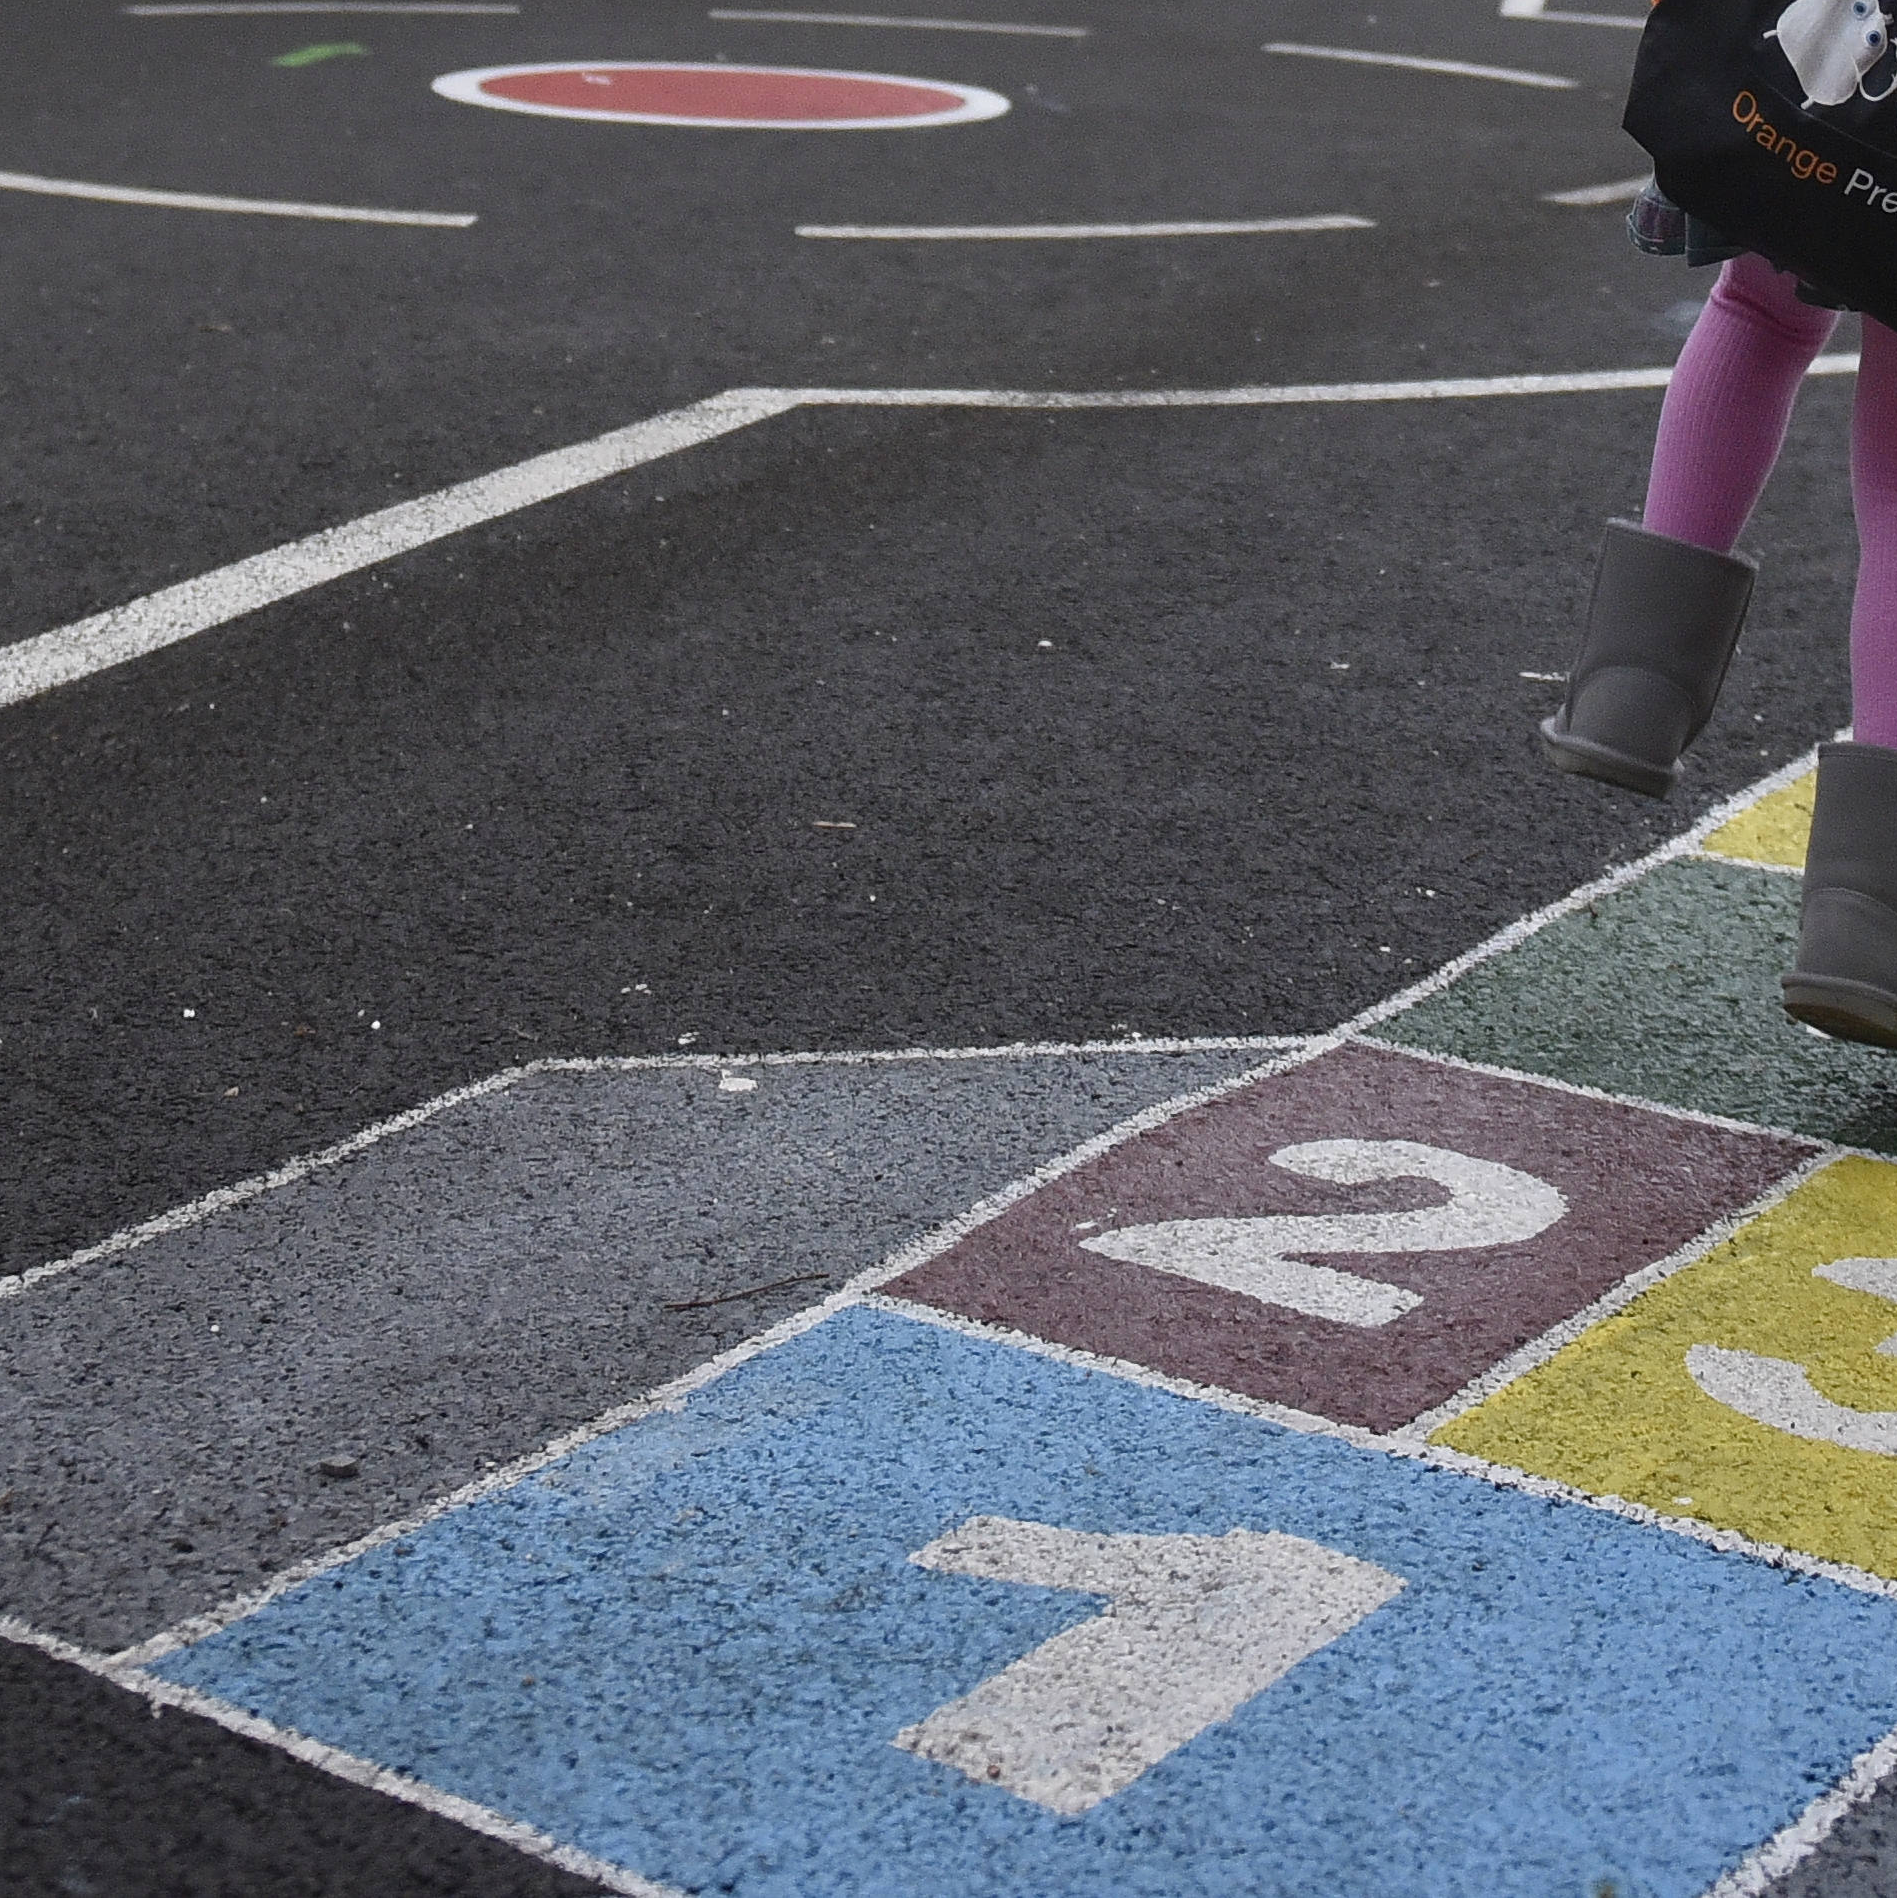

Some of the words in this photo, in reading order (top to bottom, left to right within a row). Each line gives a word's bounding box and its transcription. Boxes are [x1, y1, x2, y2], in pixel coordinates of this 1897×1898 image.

[1732, 90, 1838, 185] Orange
[1077, 1138, 1571, 1328] 2
[891, 1514, 1408, 1815] 1
